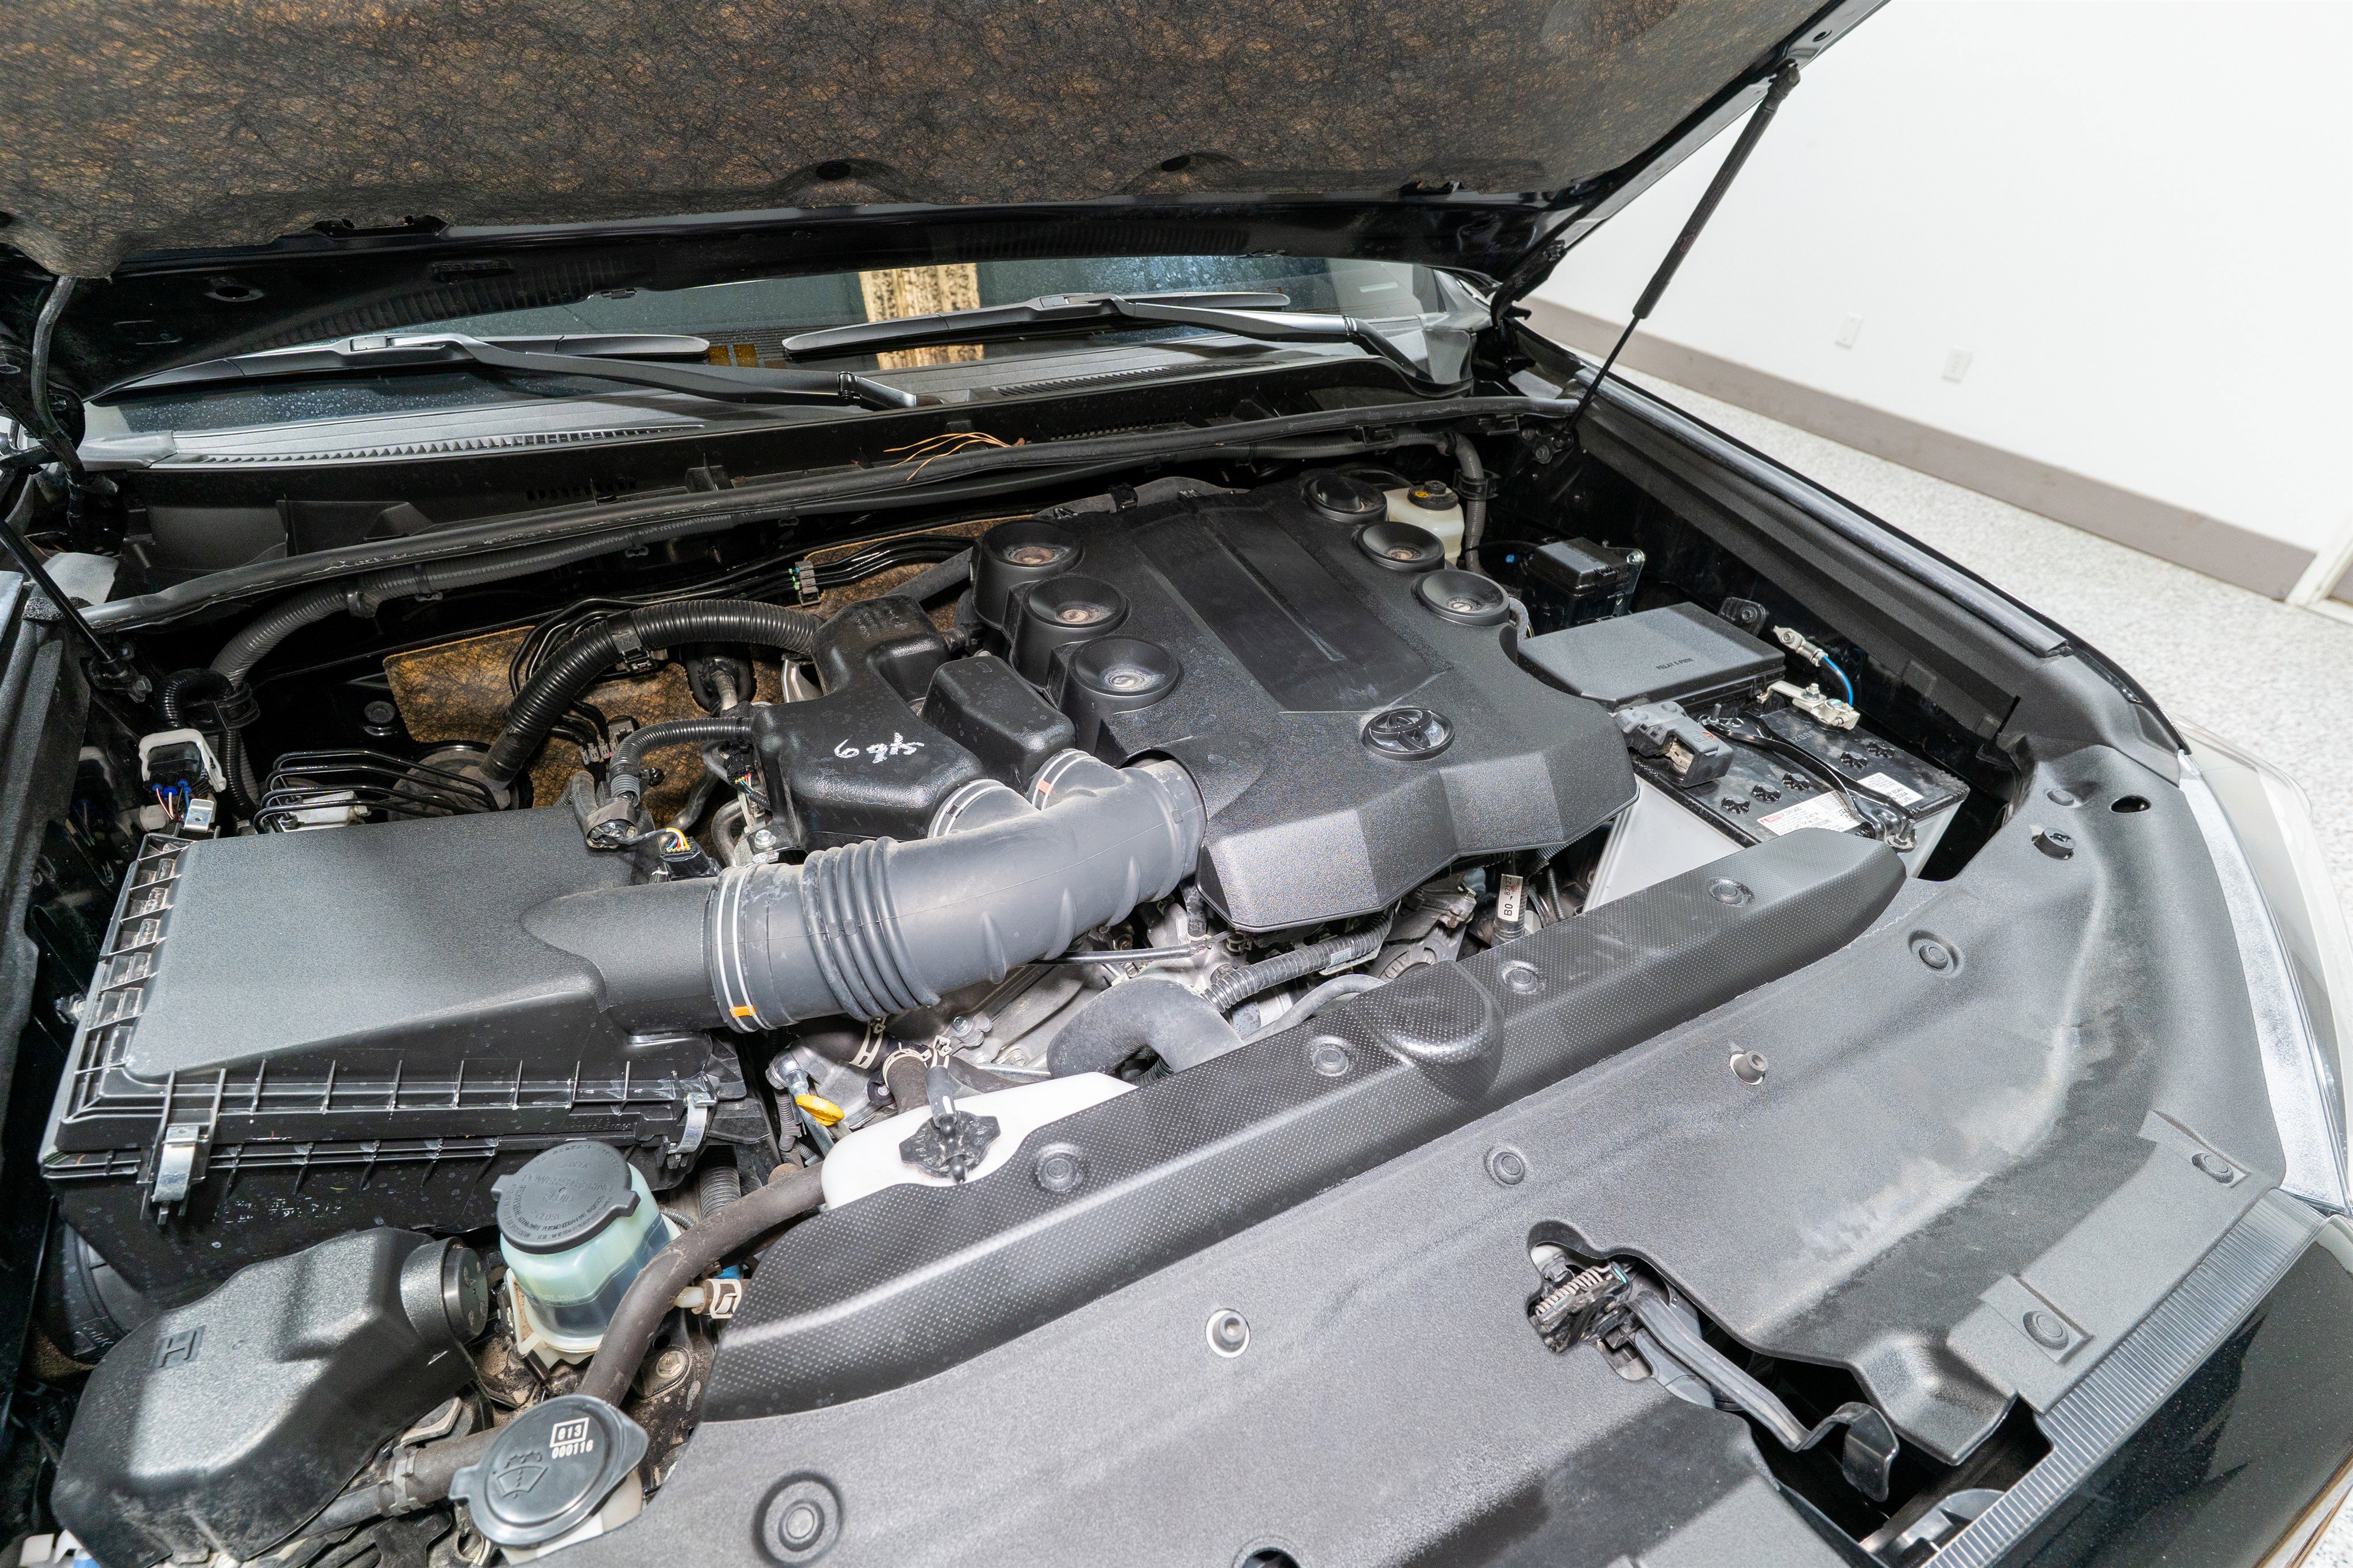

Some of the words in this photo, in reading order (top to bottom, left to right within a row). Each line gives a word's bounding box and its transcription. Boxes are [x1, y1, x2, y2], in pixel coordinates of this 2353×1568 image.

[569, 1161, 590, 1169] OPEN
[522, 1173, 560, 1186] POWER
[543, 1191, 574, 1204] FLUID
[535, 1212, 562, 1221] CLOSE
